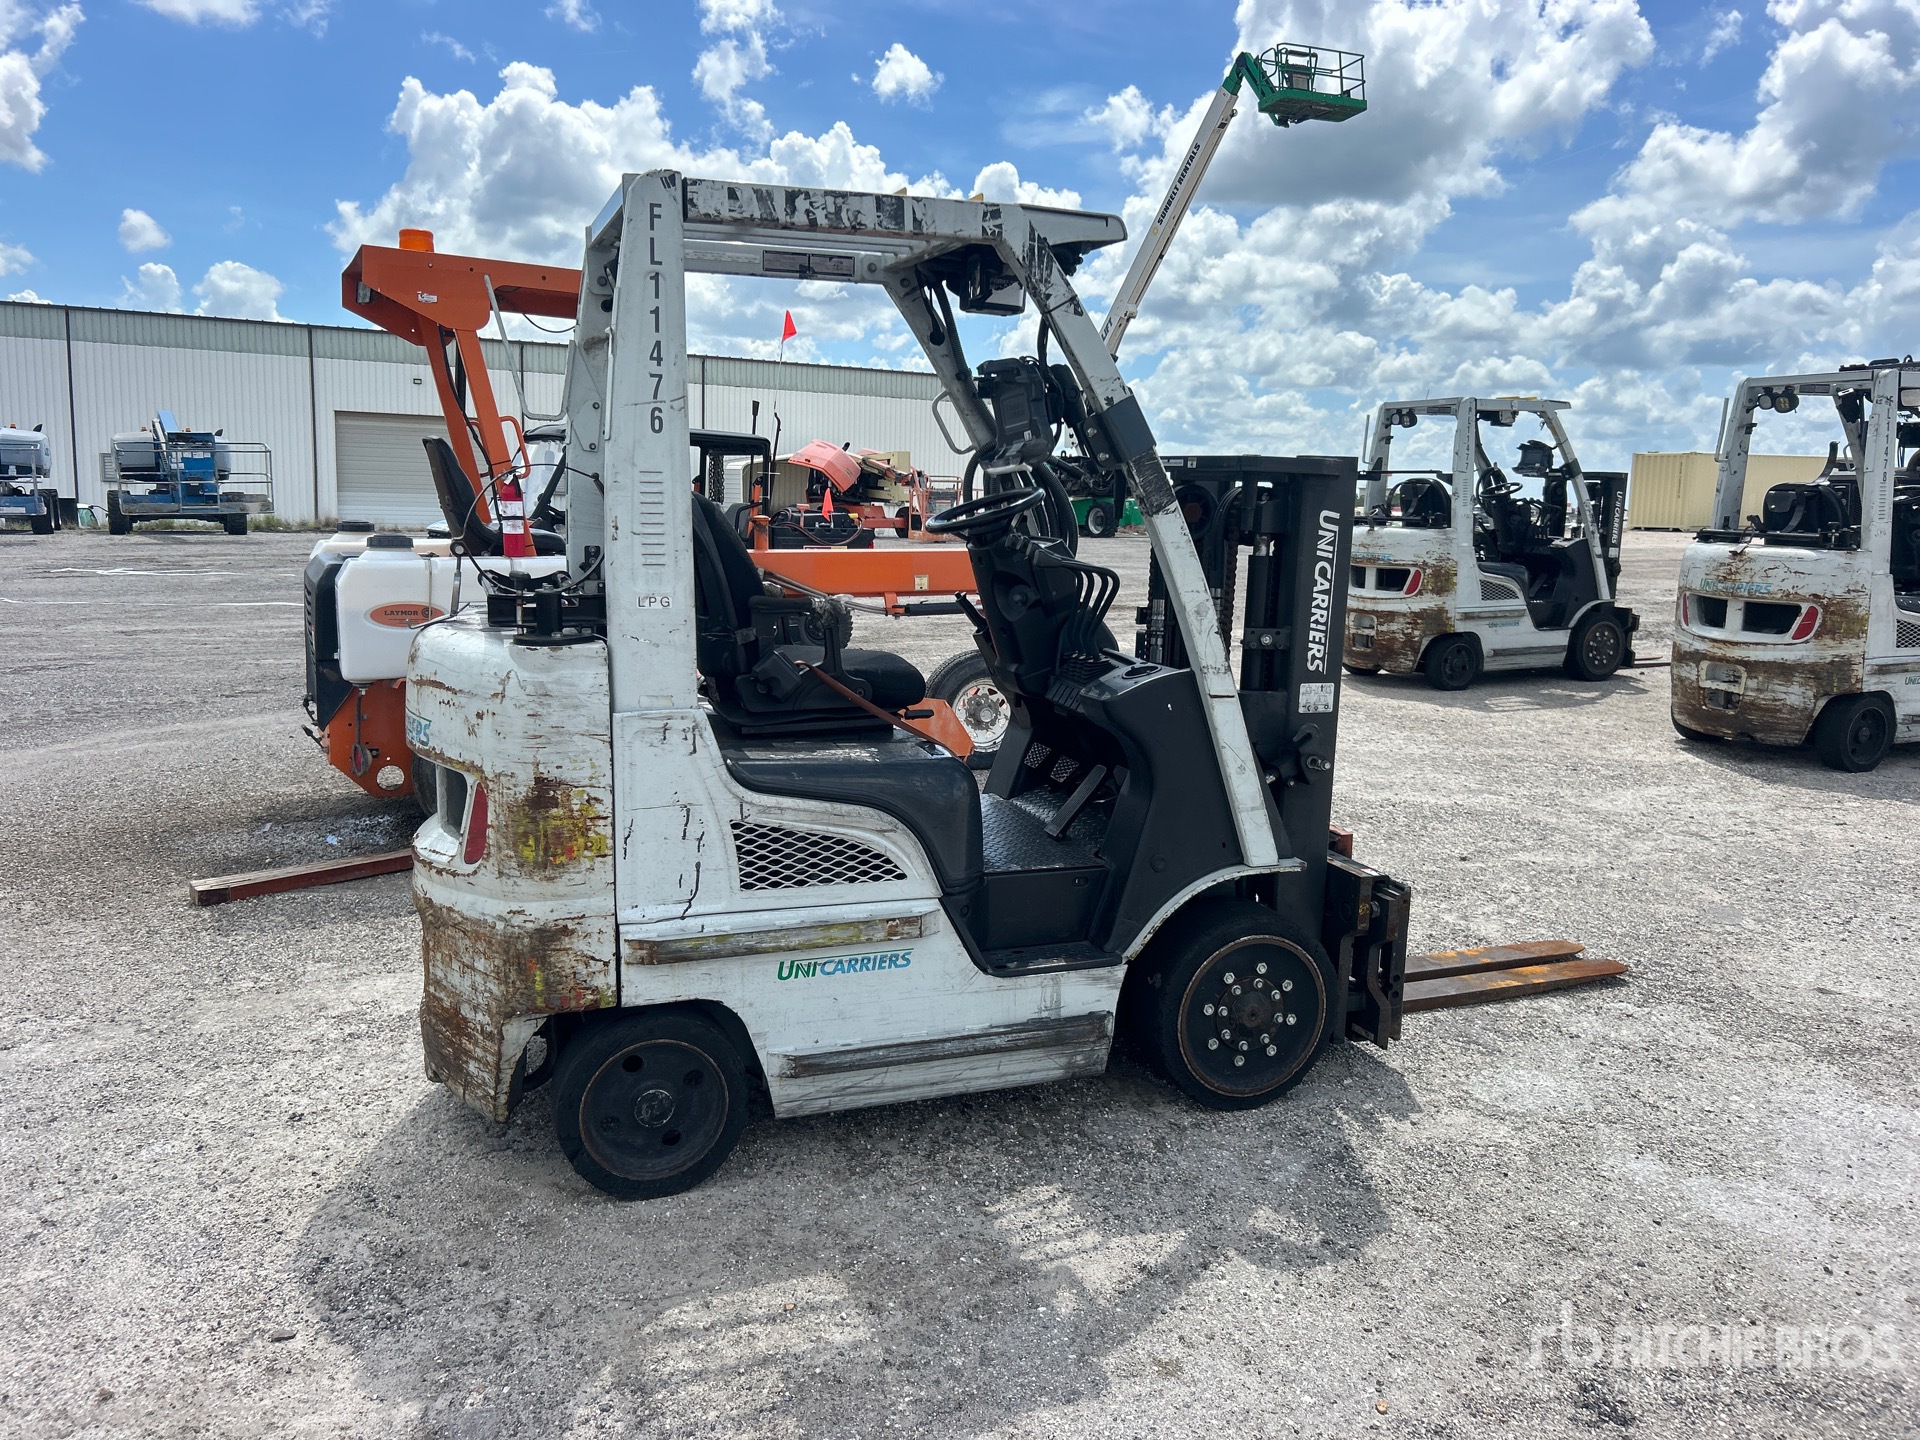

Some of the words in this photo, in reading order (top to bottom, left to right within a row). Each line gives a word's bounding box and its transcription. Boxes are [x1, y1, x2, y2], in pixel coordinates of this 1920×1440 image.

[1158, 184, 1180, 225] SUNBELT
[1177, 142, 1201, 186] RENTALS
[649, 203, 664, 434] FL11476
[637, 596, 671, 608] LPG
[777, 950, 914, 981] UNICARRIERS
